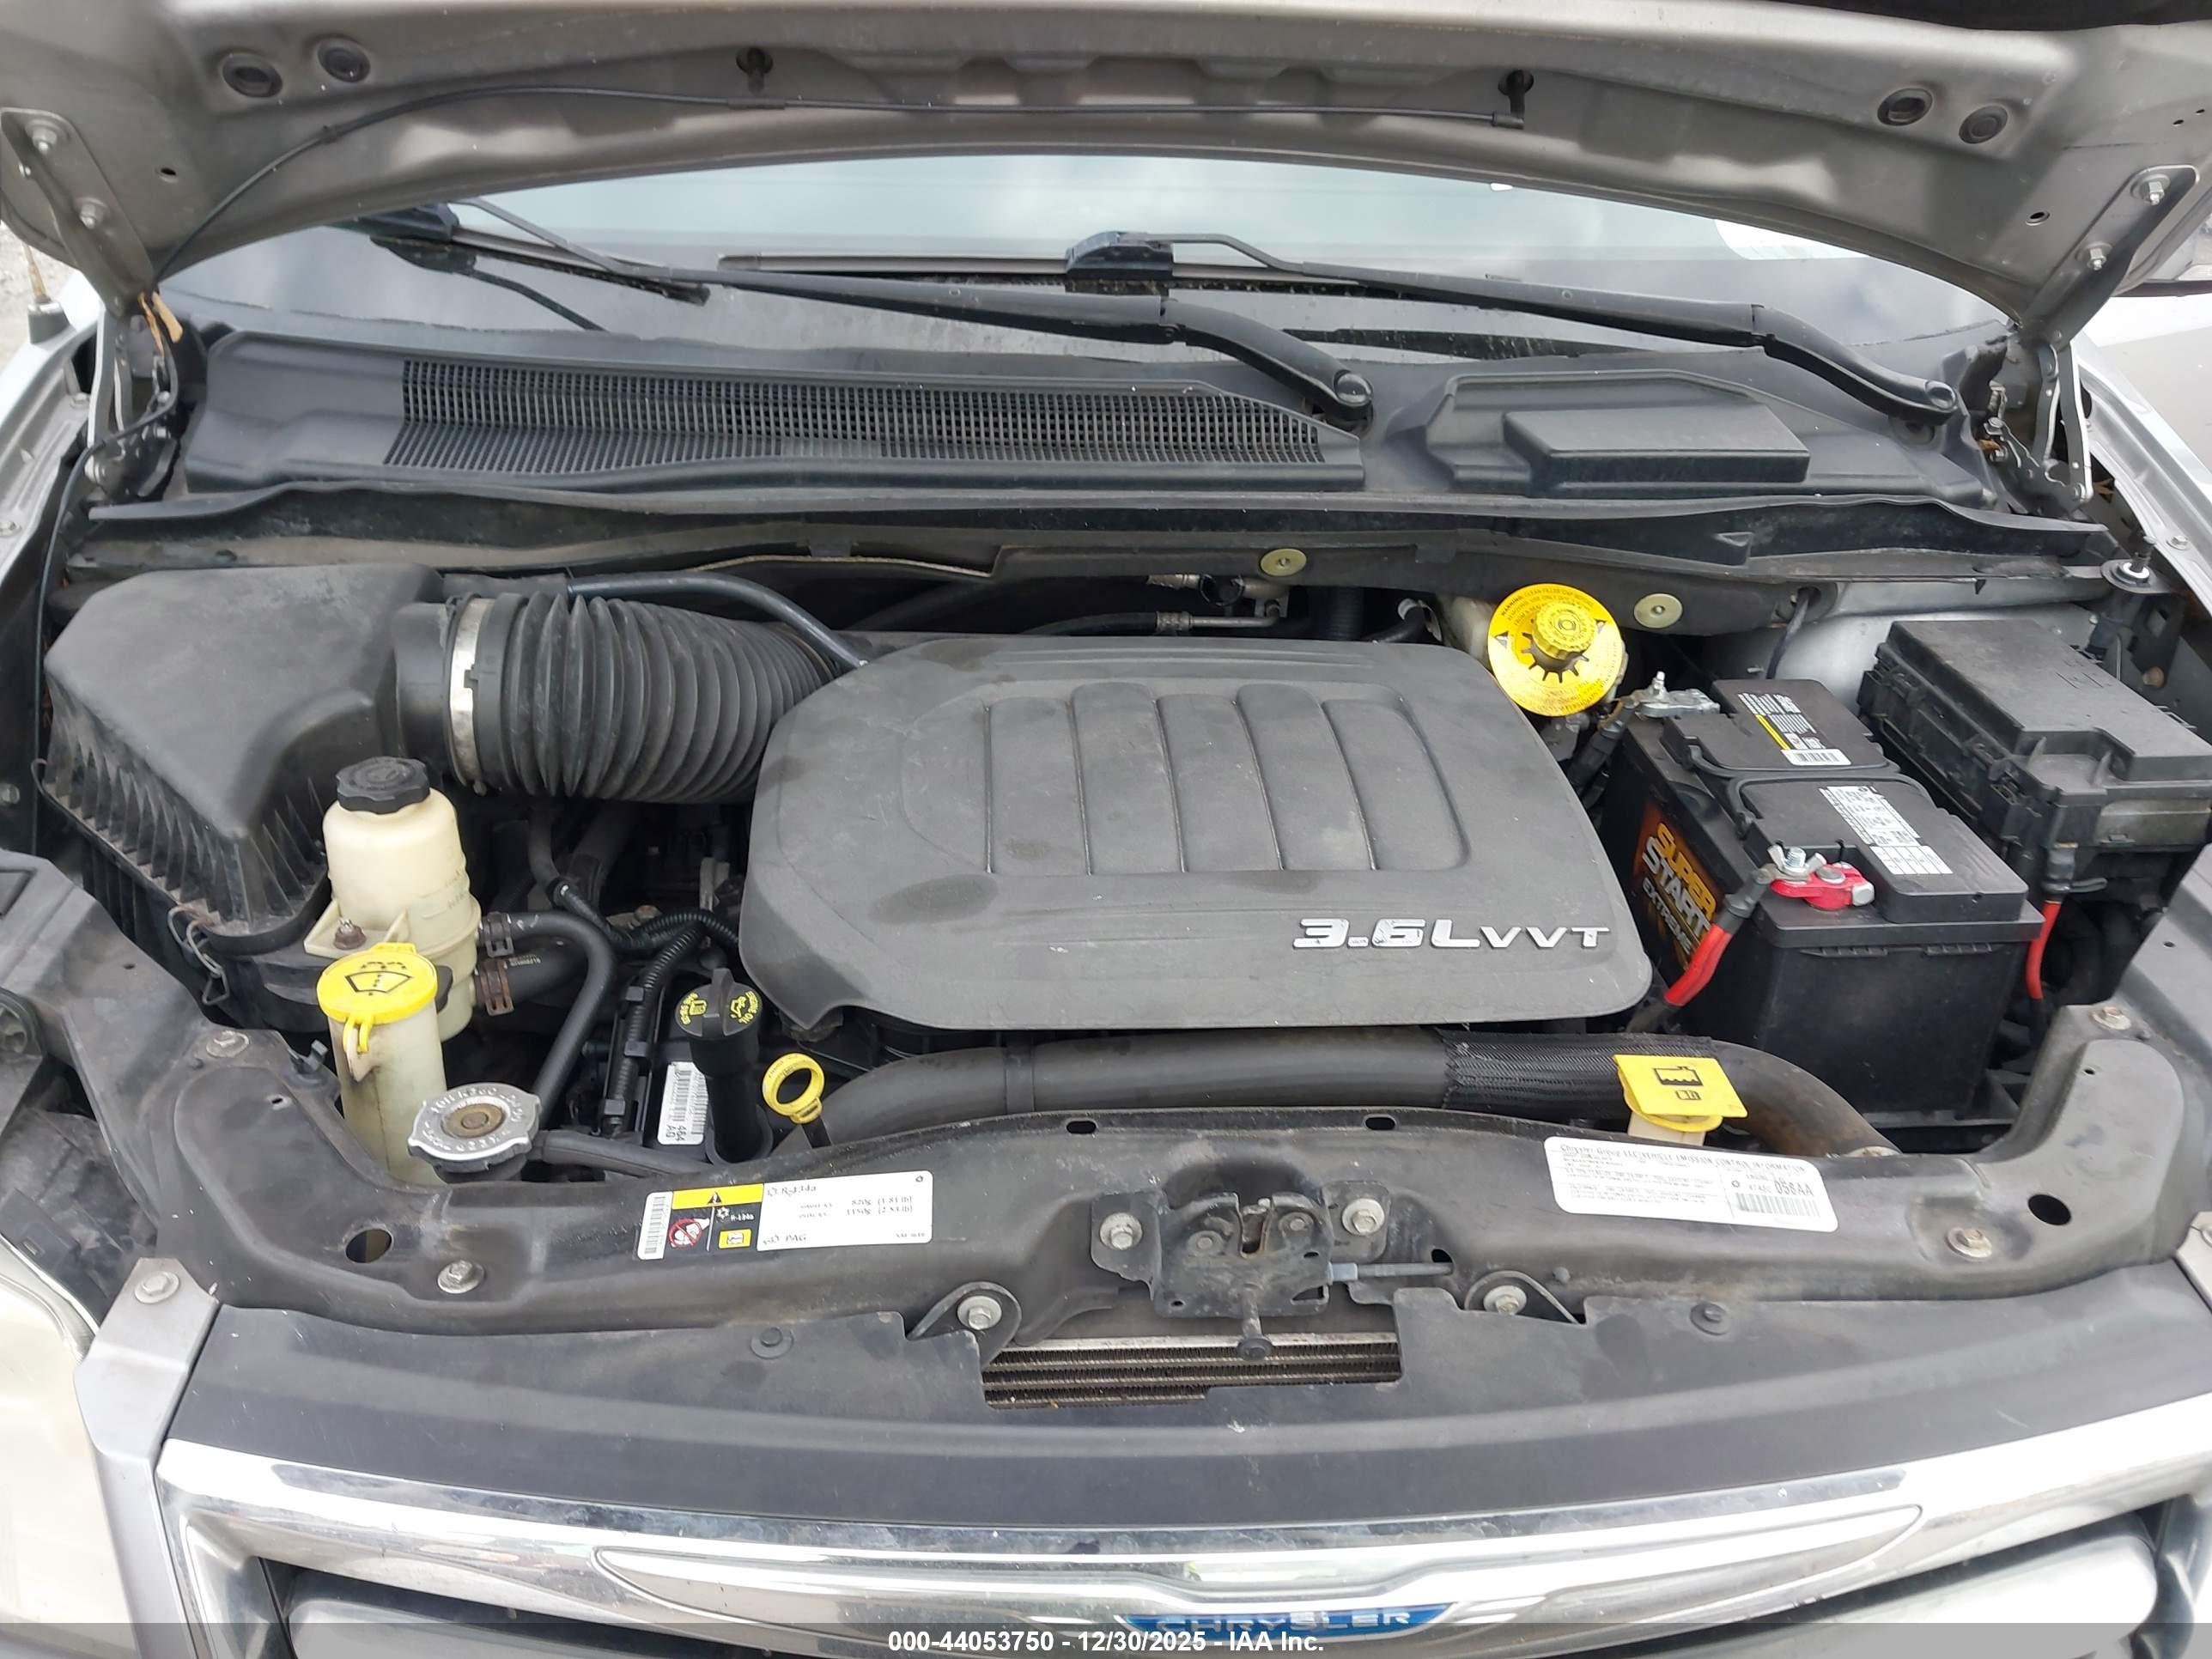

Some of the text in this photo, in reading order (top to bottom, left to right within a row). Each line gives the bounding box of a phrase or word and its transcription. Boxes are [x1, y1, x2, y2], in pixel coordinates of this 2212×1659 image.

[1642, 836, 1711, 940] START
[1655, 823, 1717, 921] SUPER
[1480, 927, 1610, 948] VVT
[1155, 1612, 1412, 1632] CHRYSLER
